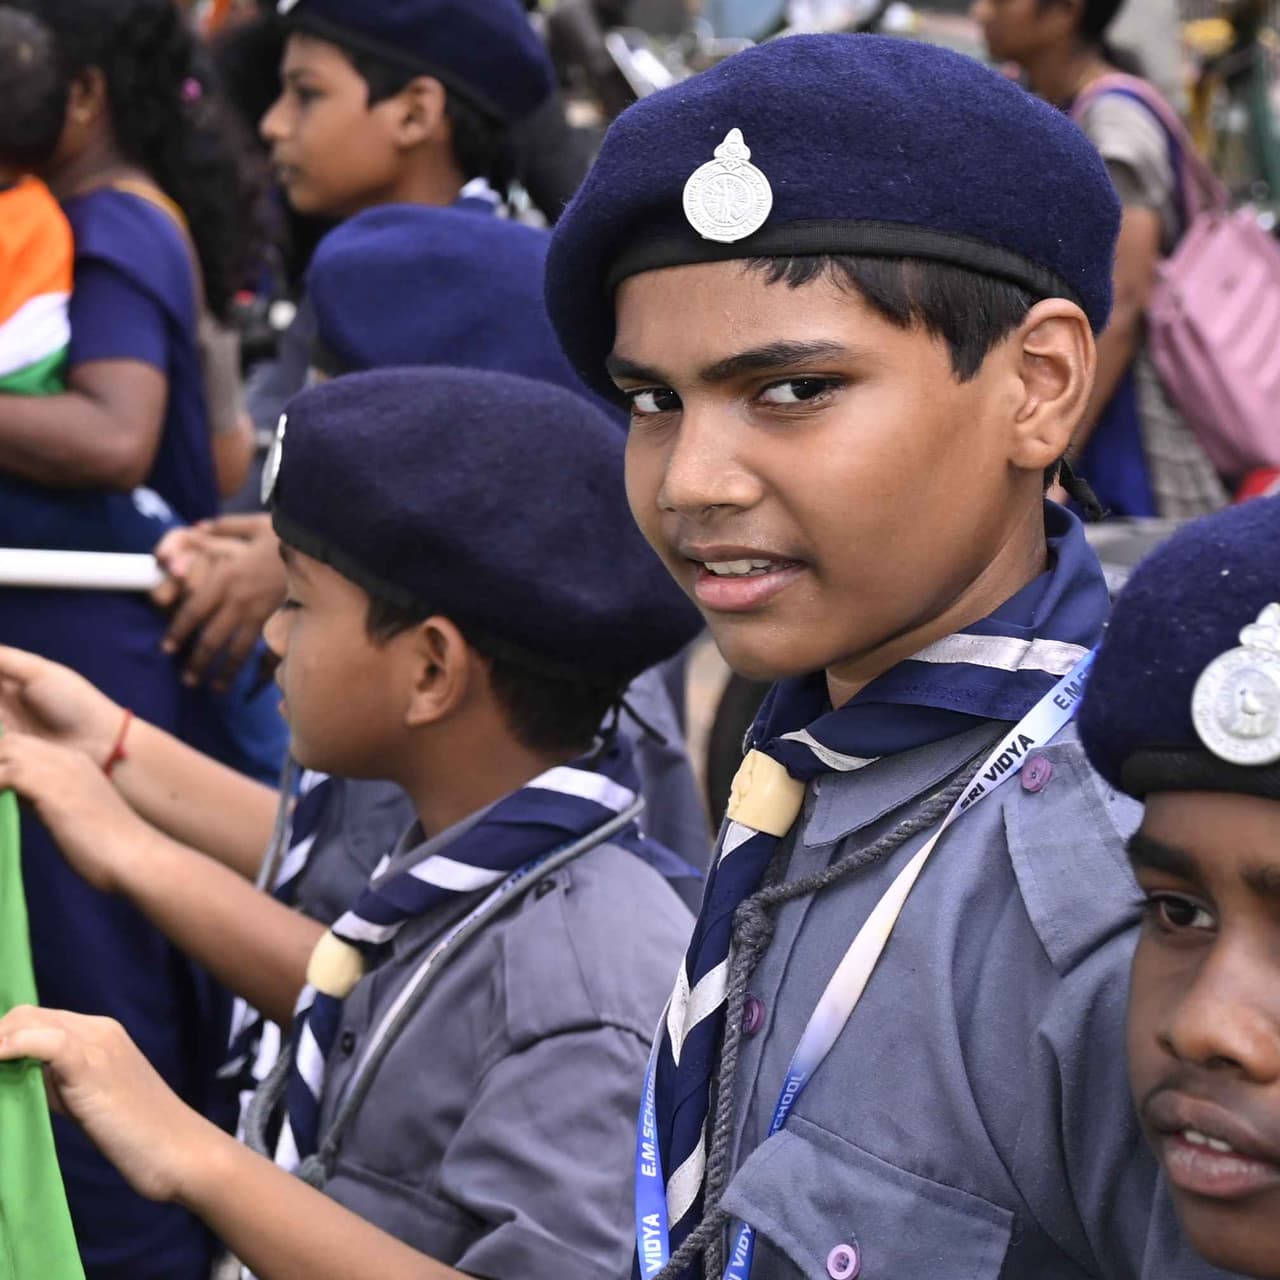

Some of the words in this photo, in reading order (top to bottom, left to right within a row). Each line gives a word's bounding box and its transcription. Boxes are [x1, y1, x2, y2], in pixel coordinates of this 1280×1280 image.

[960, 782, 986, 810] SRI
[983, 734, 1035, 782] VIDYA
[731, 1223, 752, 1267] VIDY
[771, 1071, 807, 1134] CHOOL
[642, 1213, 662, 1273] VIDYA
